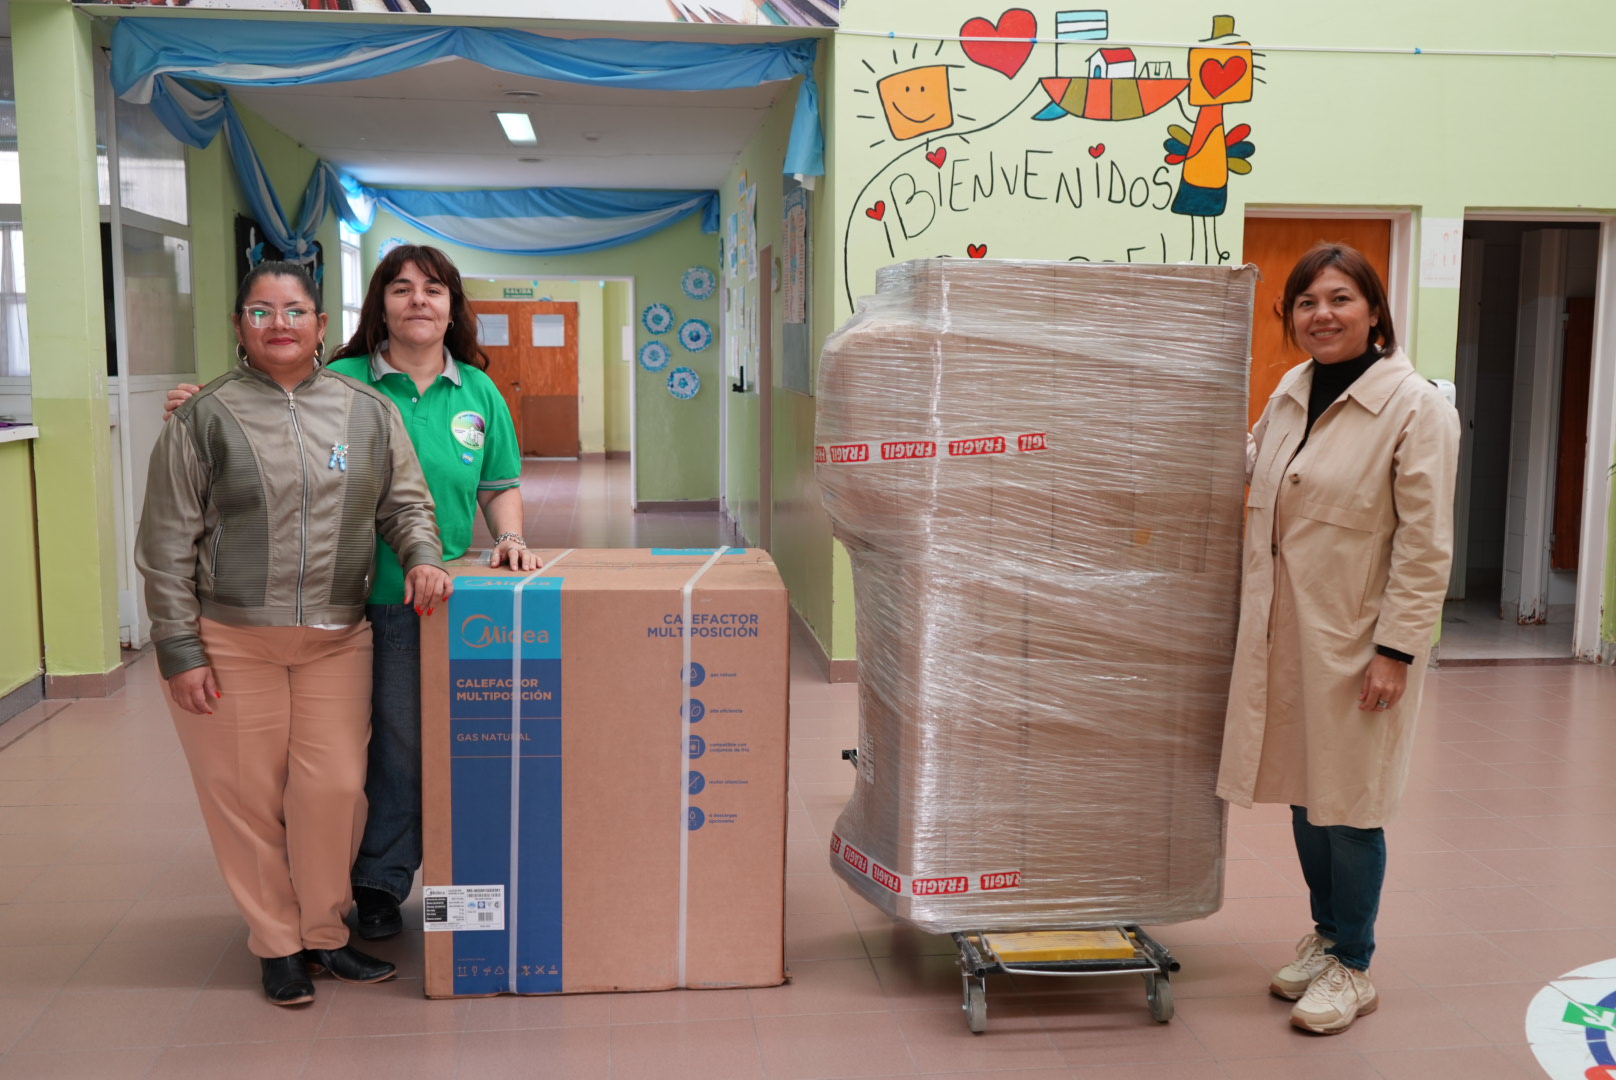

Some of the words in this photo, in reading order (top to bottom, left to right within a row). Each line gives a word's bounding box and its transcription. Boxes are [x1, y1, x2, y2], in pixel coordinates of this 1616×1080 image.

[883, 442, 933, 459] FRAGIL
[951, 437, 1004, 454] FRAGIL
[831, 445, 866, 462] FRAGIL
[663, 614, 759, 625] CAEFACTOR
[647, 625, 759, 638] MULTPOSICIÓN
[456, 678, 539, 688] CALEFACOR
[456, 690, 552, 701] MULTIPOCIÓN
[456, 733, 479, 741] GAS
[481, 733, 532, 741] NATUAL
[873, 865, 899, 890] FRAGIL
[915, 878, 966, 894] FRAGIL
